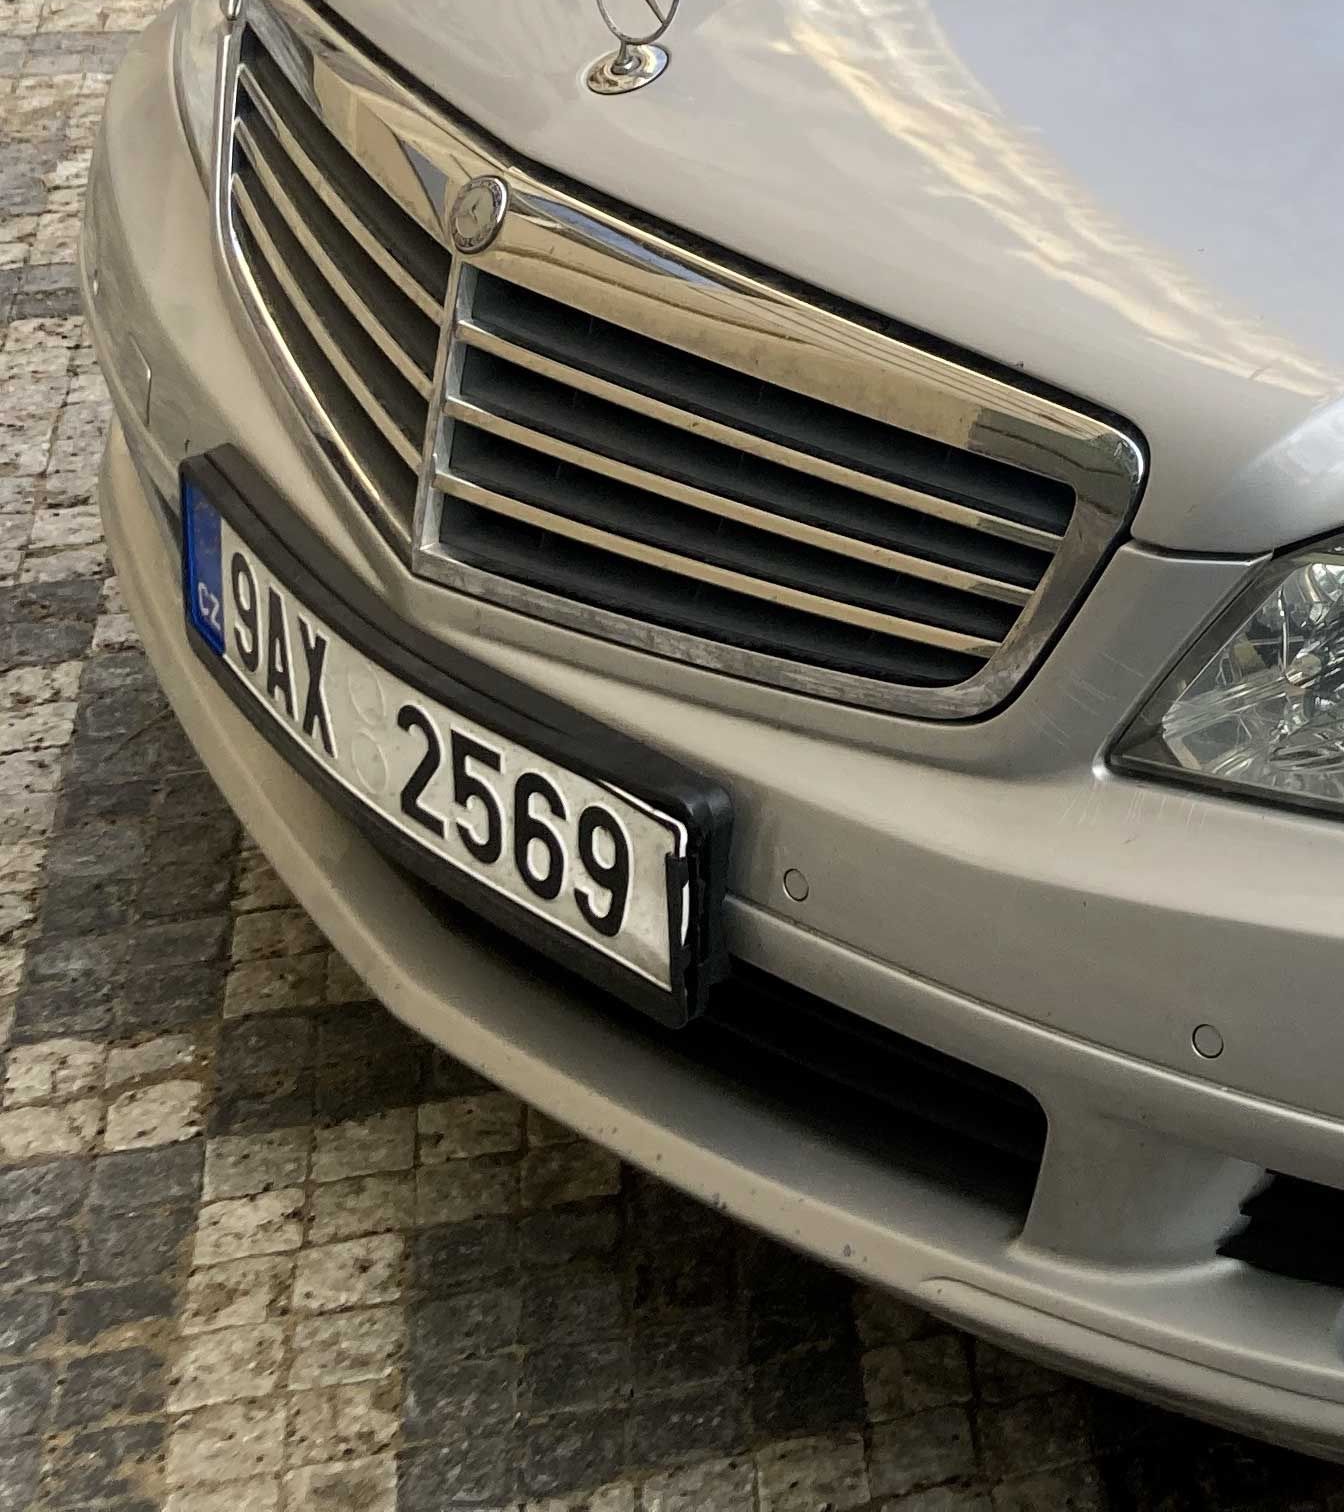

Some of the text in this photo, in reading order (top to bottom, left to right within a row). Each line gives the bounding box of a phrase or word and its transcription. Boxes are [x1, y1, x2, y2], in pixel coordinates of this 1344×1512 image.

[198, 581, 223, 631] CZ
[231, 551, 630, 937] 9AX 2569
